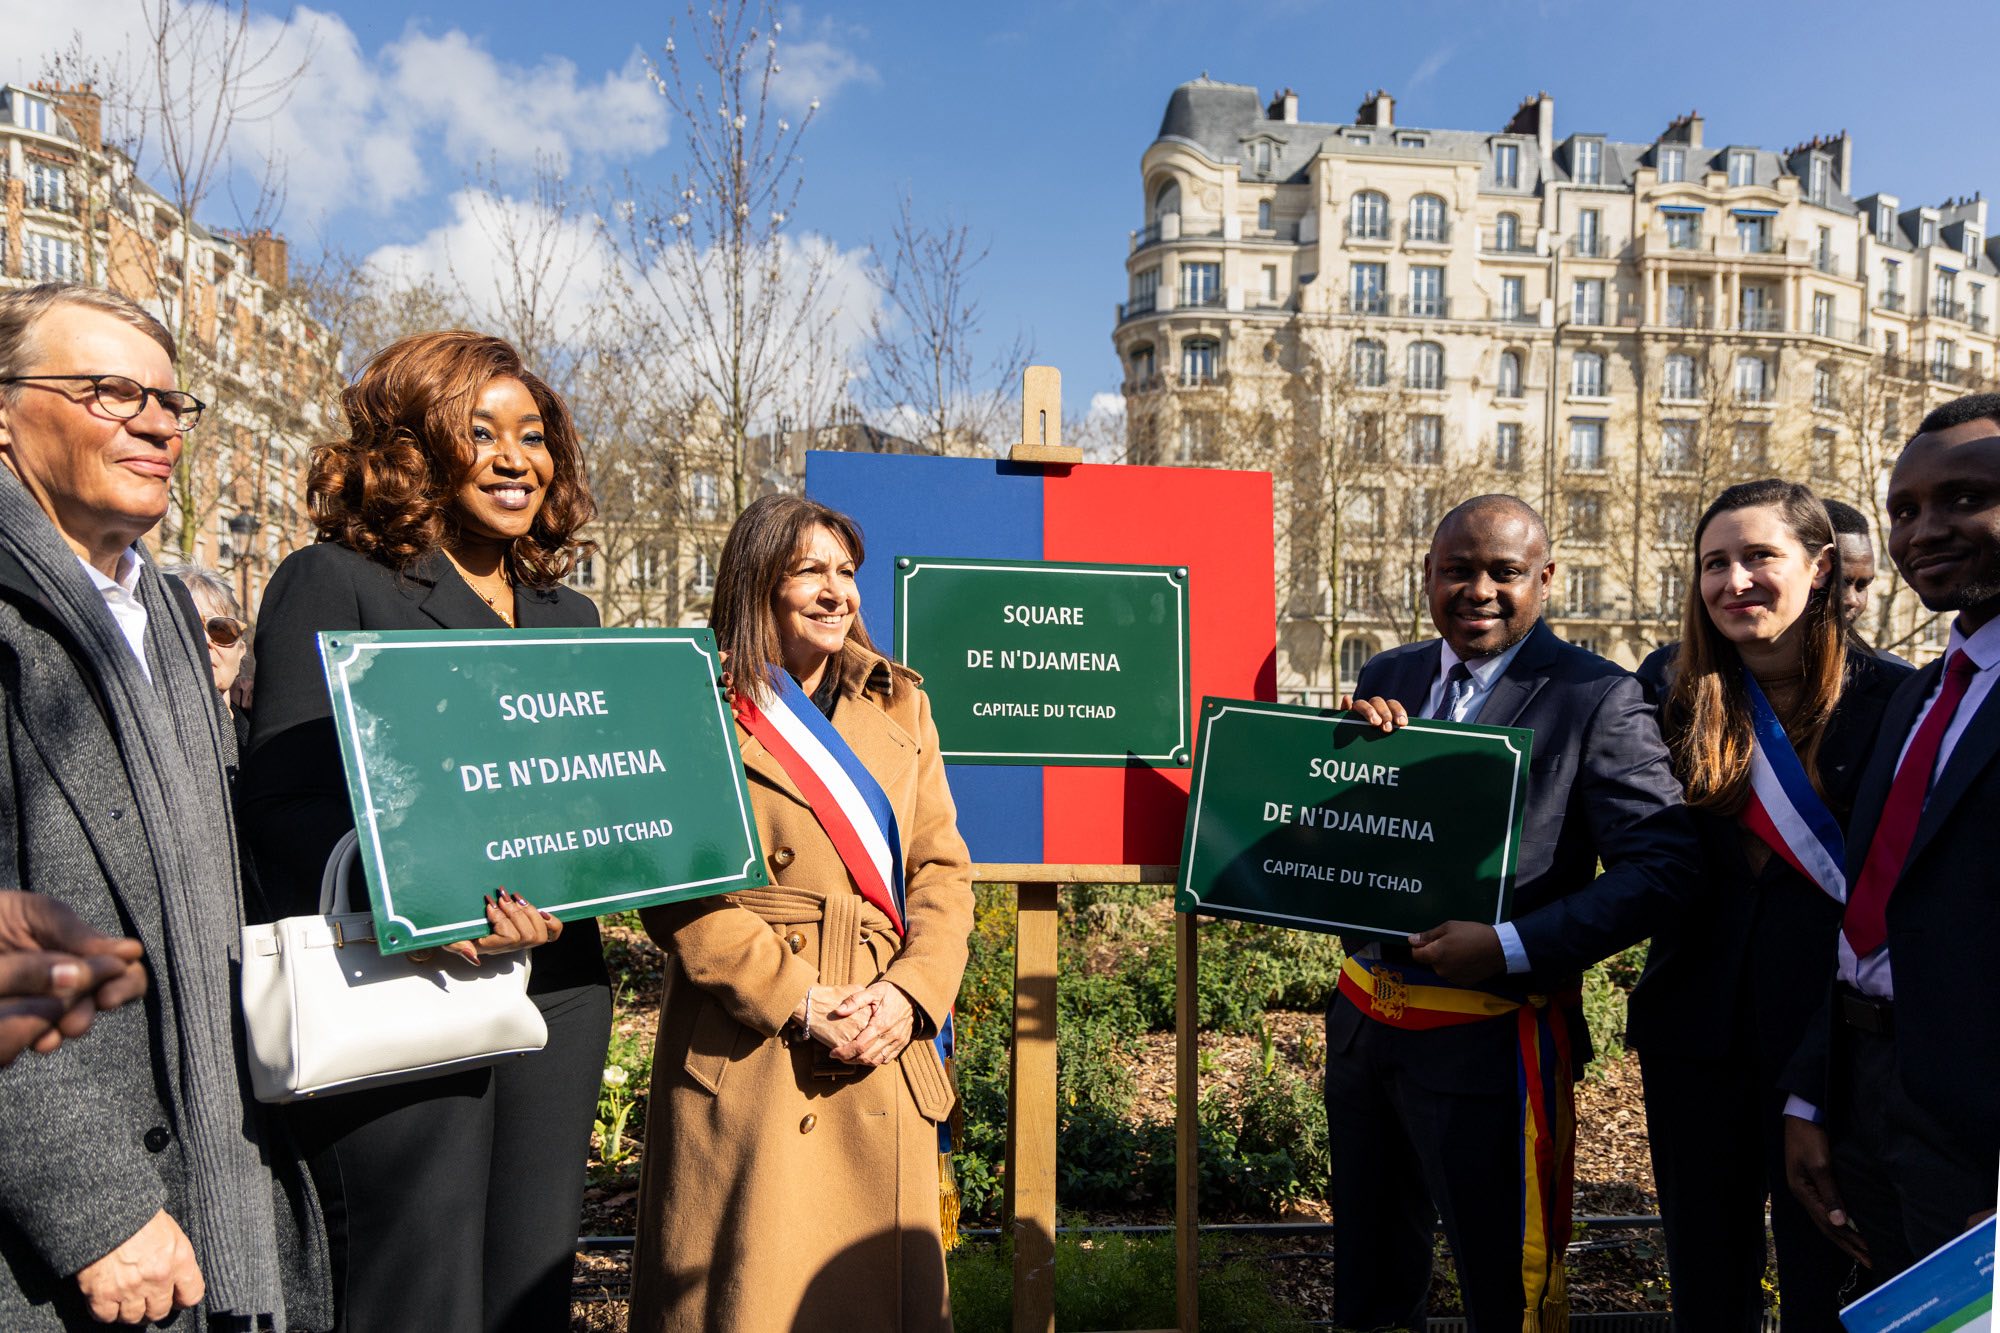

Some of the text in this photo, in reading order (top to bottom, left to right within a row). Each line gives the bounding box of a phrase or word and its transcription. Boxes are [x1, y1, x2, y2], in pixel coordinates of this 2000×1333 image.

[1004, 605, 1084, 626] SQUARE
[967, 650, 1121, 672] DE N'DJAMENA
[500, 691, 608, 723] SQUARE
[973, 703, 1116, 719] CAPITALE DU TCHAD
[460, 749, 667, 792] DE N'DJAMENA
[1309, 758, 1400, 787] SQUARE
[1263, 802, 1434, 842] DE N'DJAMENA
[486, 819, 673, 861] CAPITALE DU TCHAD
[1263, 859, 1422, 893] CAPITALE DU TCHAD
